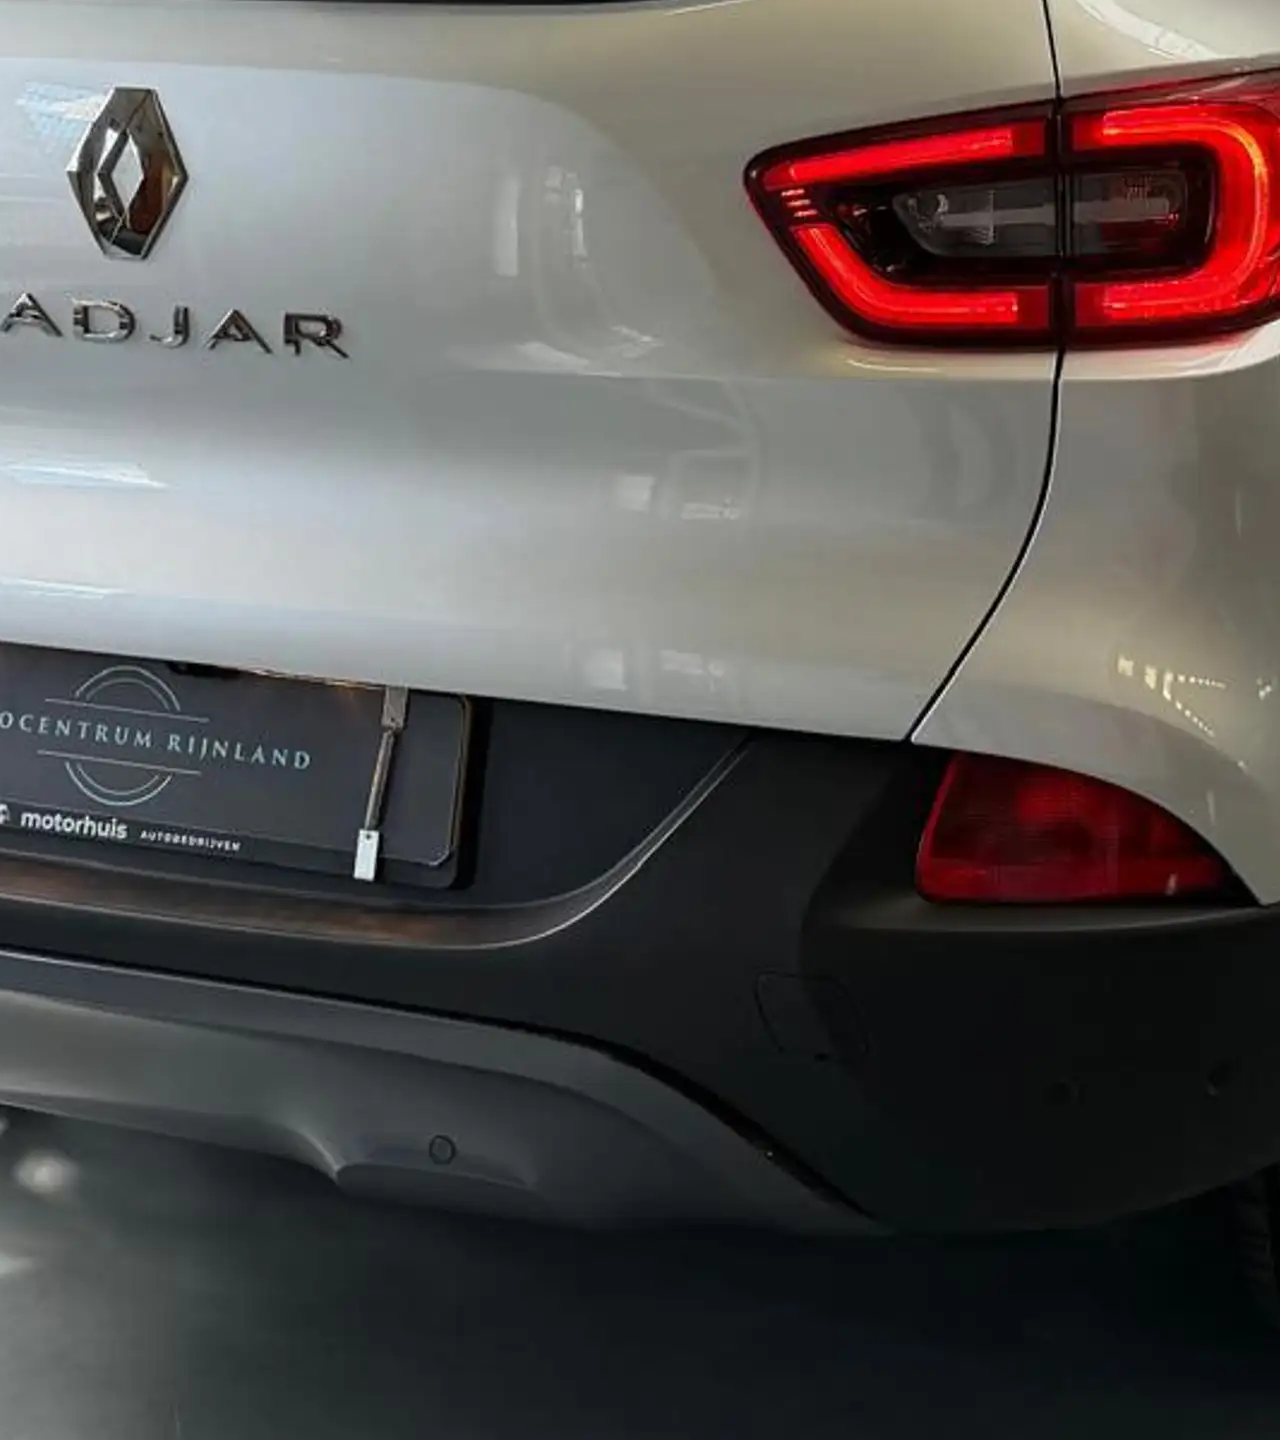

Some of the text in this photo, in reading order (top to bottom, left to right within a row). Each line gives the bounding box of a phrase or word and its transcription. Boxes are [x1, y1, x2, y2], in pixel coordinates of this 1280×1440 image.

[168, 734, 311, 770] RIJNLAND
[20, 811, 241, 851] motorhuis AUTOBEDRIJVEN
